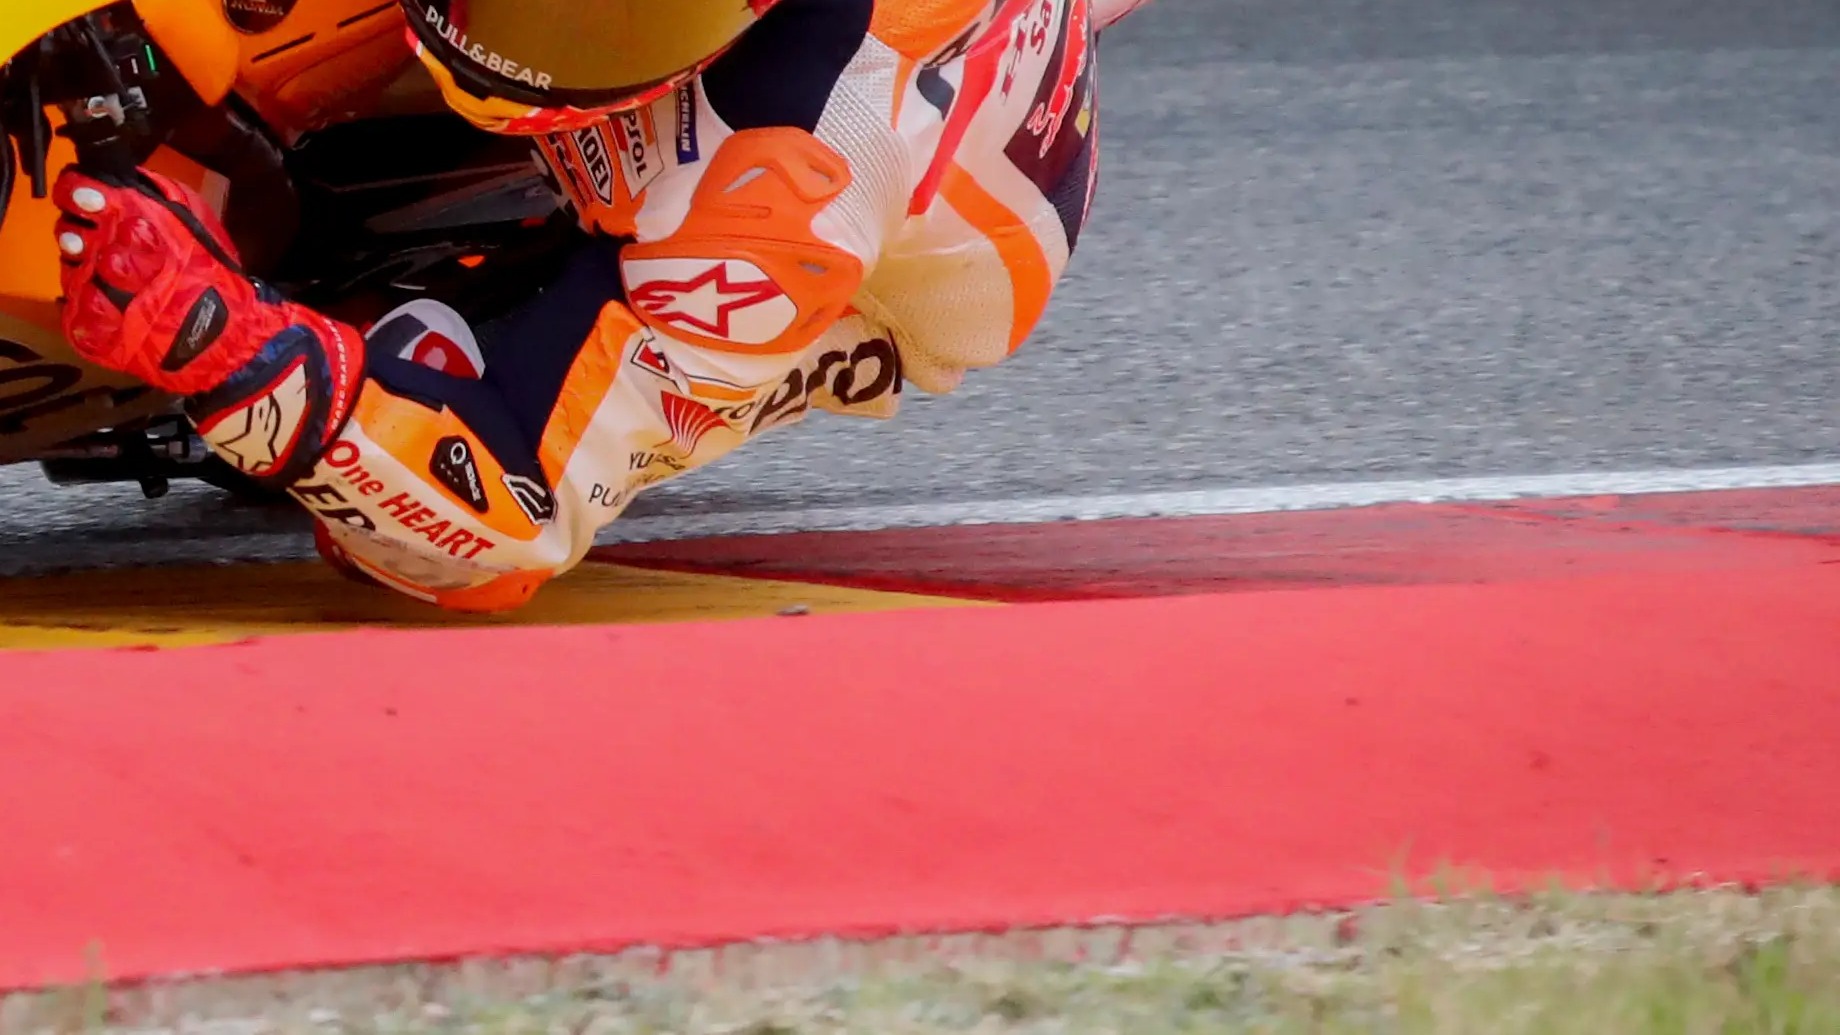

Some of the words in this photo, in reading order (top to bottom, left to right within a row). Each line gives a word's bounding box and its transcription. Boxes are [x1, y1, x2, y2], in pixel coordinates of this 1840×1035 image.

[426, 6, 552, 90] PULL&BEAR
[625, 111, 648, 178] PSOL
[328, 441, 385, 496] One
[377, 492, 495, 555] HEART
